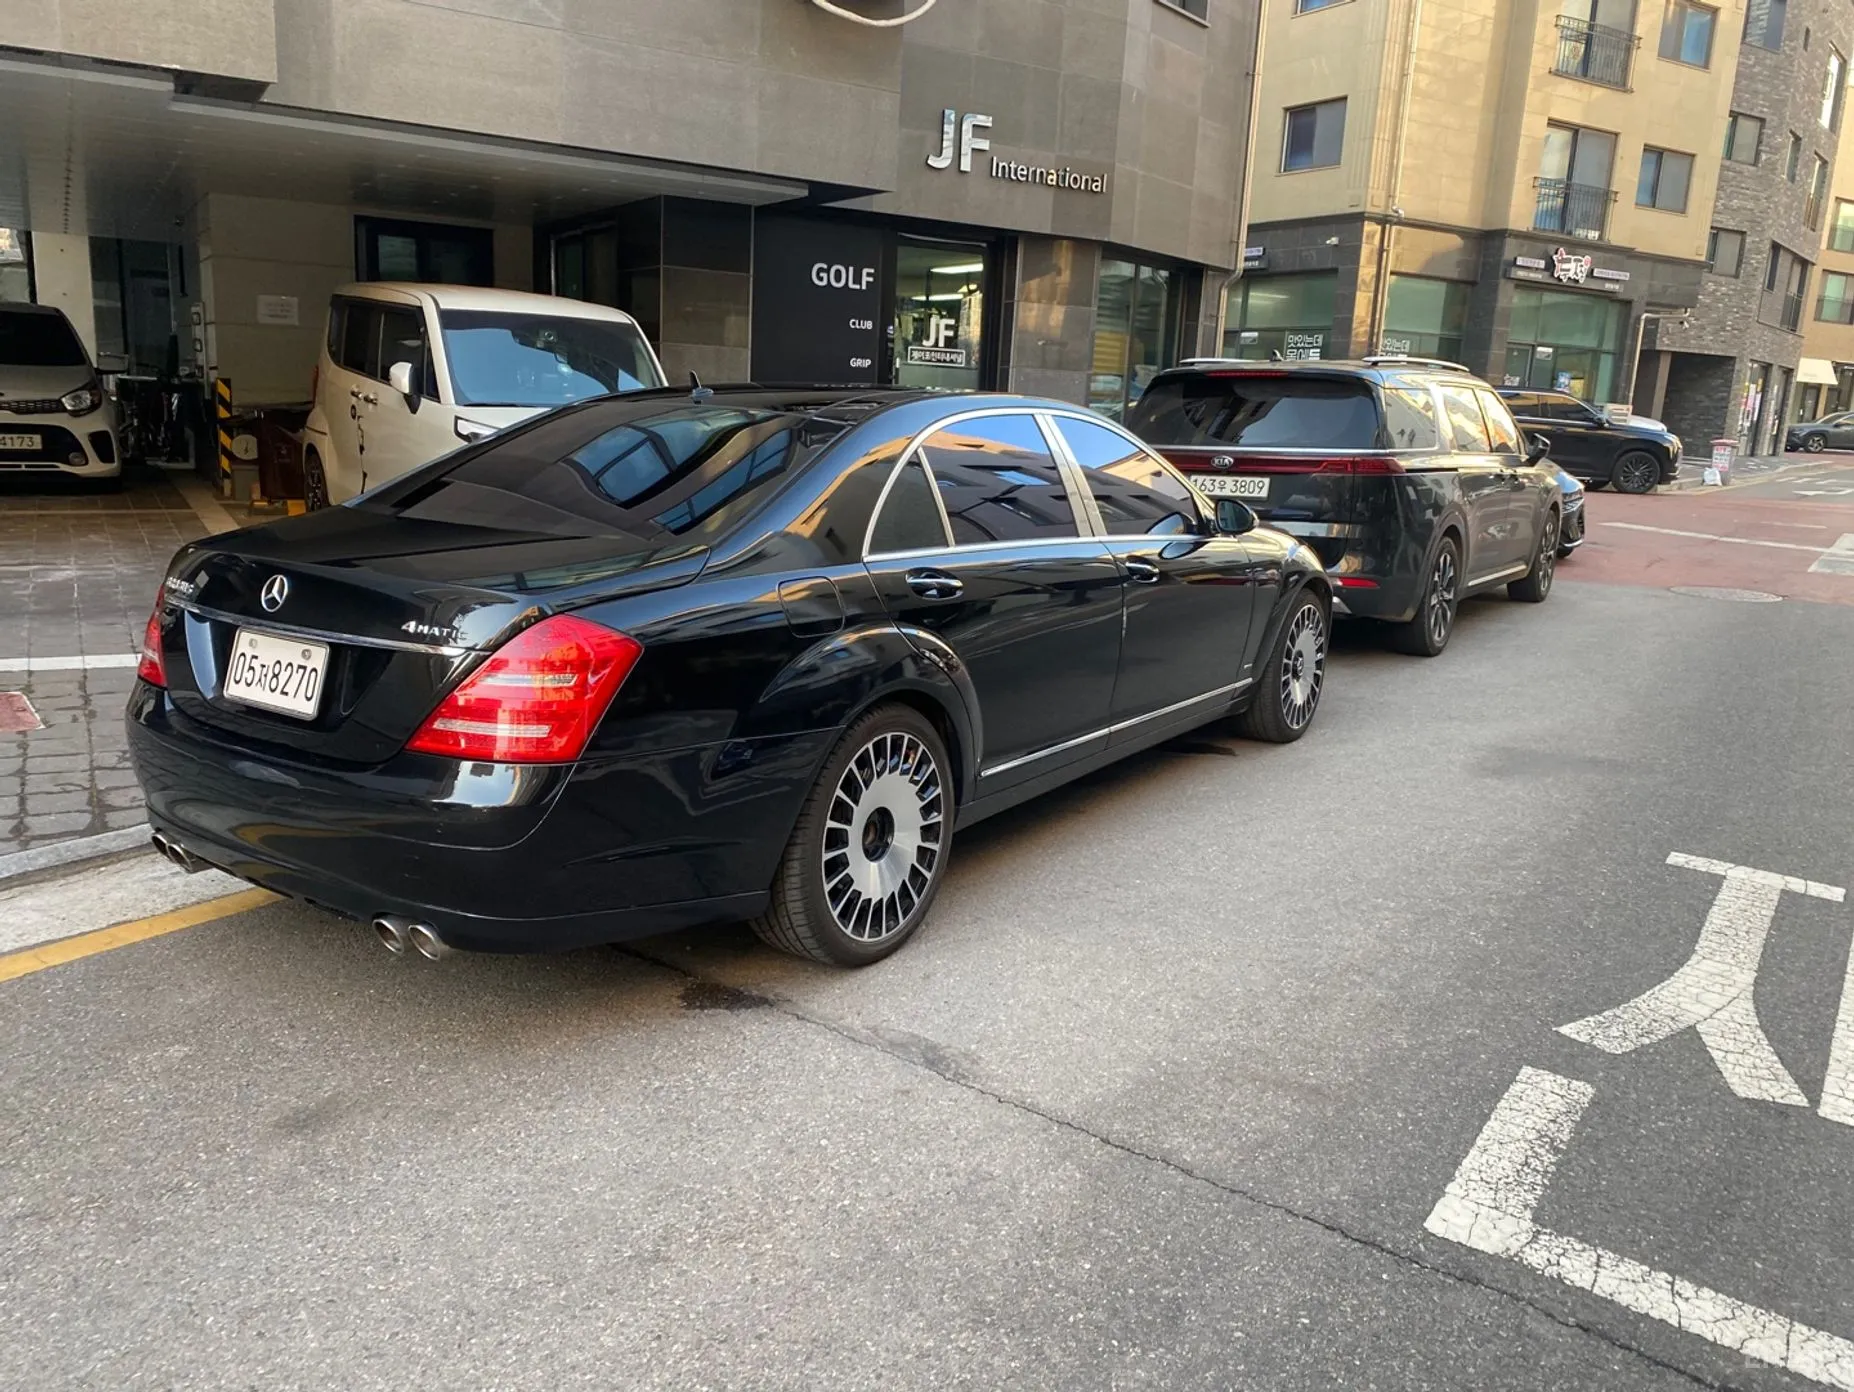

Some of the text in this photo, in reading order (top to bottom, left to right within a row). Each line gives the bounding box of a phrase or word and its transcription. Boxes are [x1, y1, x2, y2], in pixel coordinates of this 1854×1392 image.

[926, 108, 1108, 194] JF International
[811, 262, 875, 290] GOLF
[849, 318, 873, 330] CLUB
[921, 315, 956, 348] JF
[1287, 333, 1324, 348] 맛있는데
[849, 357, 872, 369] GRIP
[1212, 456, 1232, 467] KIA
[1229, 479, 1266, 495] 3809
[400, 619, 468, 642] 4MATIC
[233, 650, 319, 702] 05저8270
